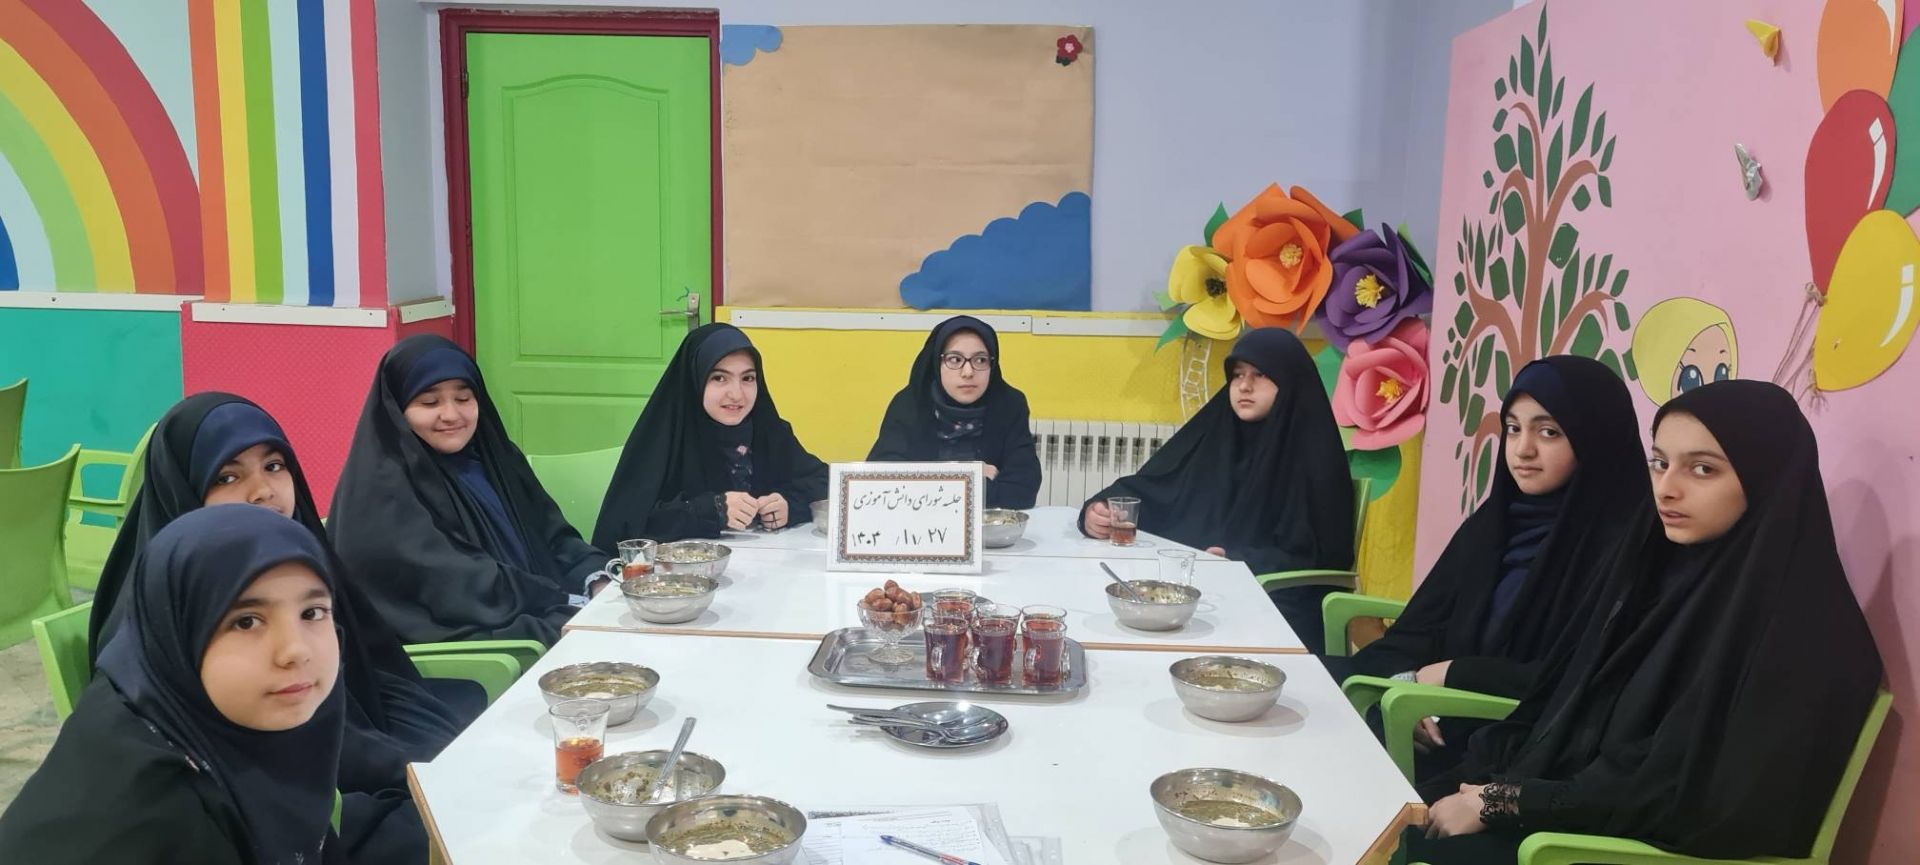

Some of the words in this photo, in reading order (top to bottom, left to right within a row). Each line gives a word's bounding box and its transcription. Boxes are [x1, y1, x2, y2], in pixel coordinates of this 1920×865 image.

[853, 490, 891, 510] آموزی
[887, 485, 913, 510] دانش
[912, 485, 943, 511] شورای
[942, 493, 962, 514] جلسه
